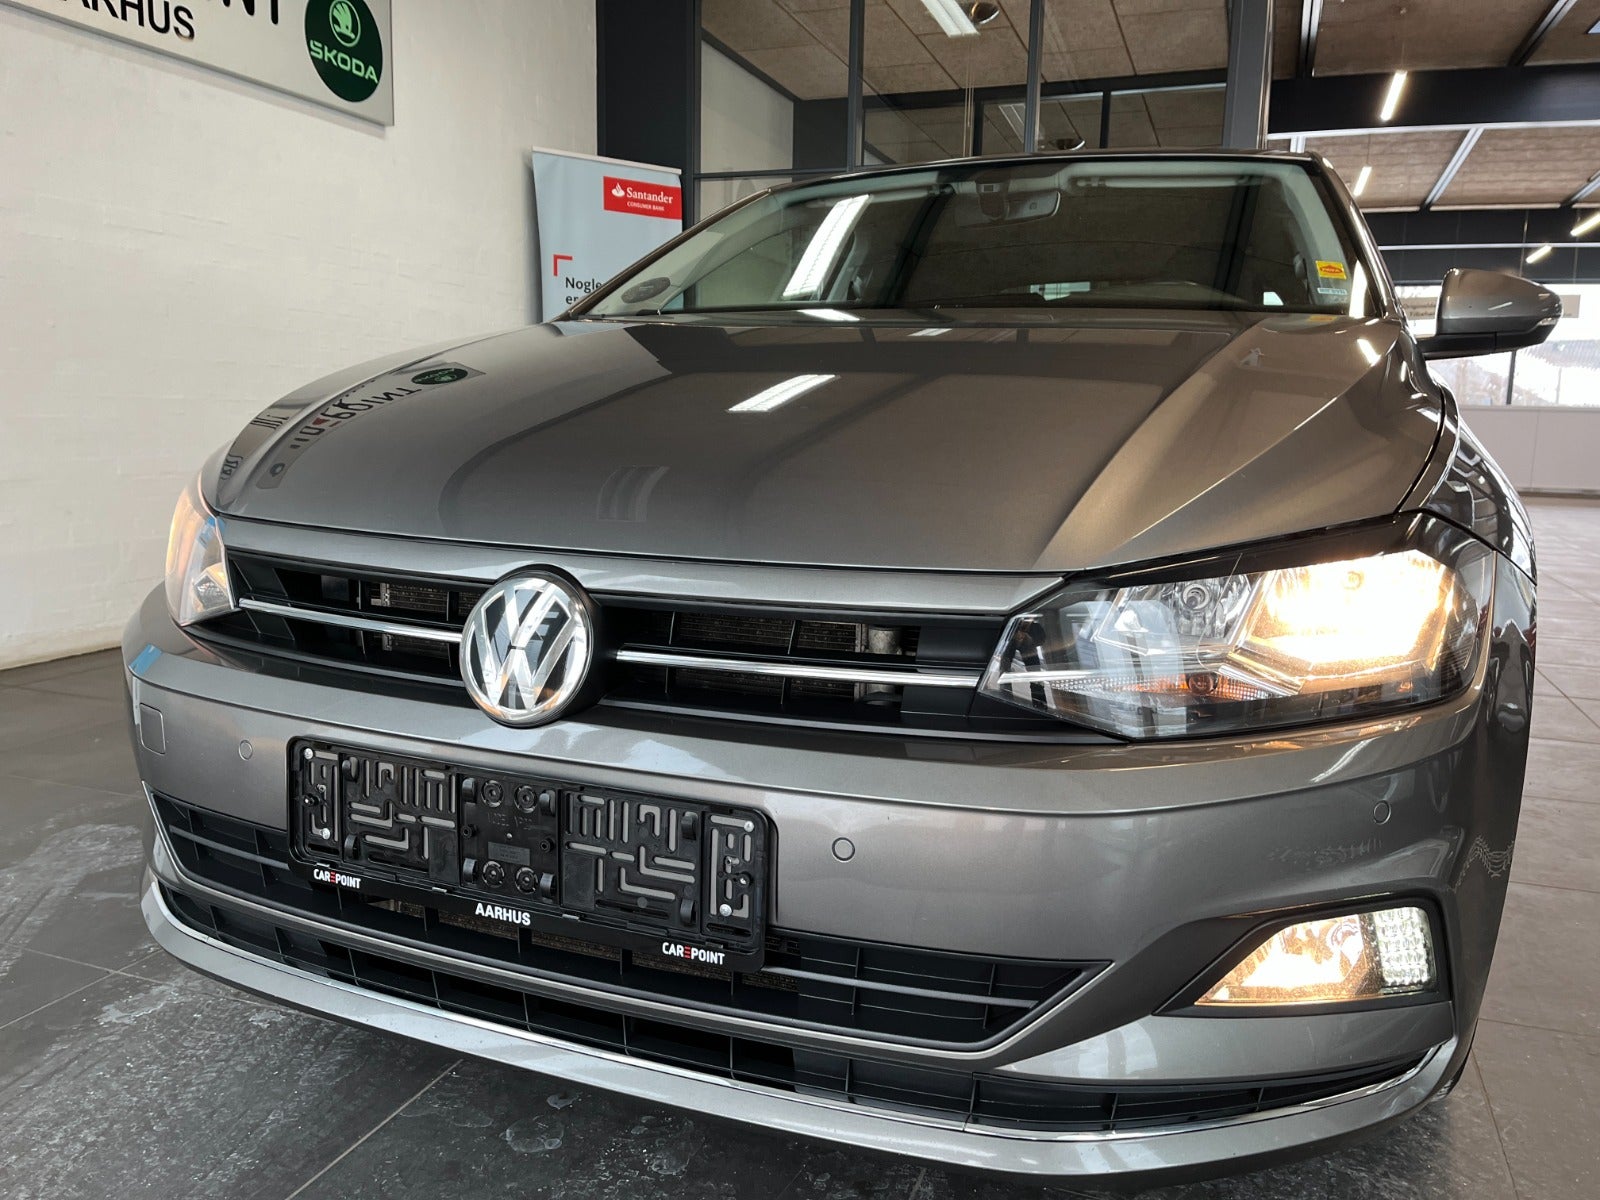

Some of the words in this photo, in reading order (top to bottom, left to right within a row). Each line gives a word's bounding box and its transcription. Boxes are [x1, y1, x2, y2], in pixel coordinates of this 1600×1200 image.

[63, 0, 196, 41] HUS
[626, 186, 674, 204] Santander
[626, 201, 652, 210] CONSUMER
[475, 902, 531, 926] AARHUS
